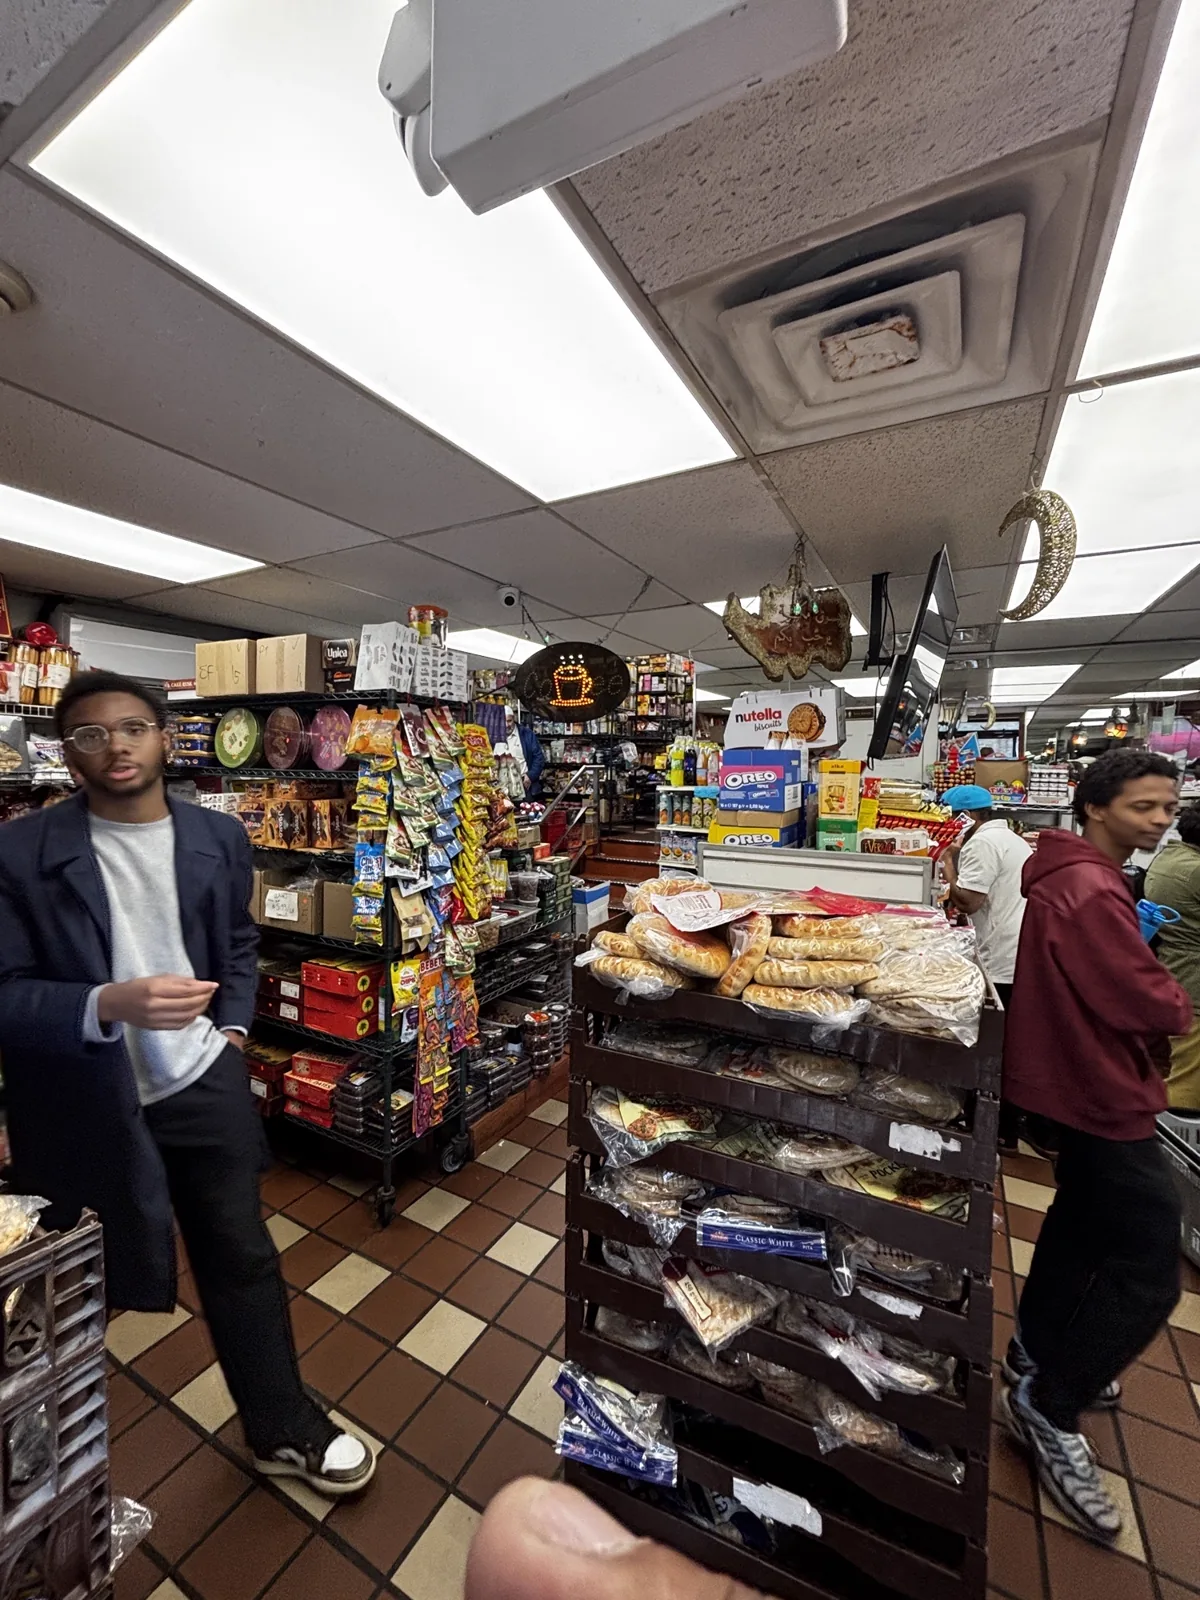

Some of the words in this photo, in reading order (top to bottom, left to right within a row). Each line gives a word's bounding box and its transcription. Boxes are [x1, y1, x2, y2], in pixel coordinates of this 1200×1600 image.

[327, 647, 348, 659] Unica
[735, 708, 782, 723] nutella
[754, 720, 783, 732] biscuits
[725, 771, 777, 789] OREO
[723, 834, 774, 846] OREO
[735, 1234, 766, 1246] CLASSIC
[768, 1237, 795, 1248] WHITE
[593, 1448, 621, 1465] CLASSIC
